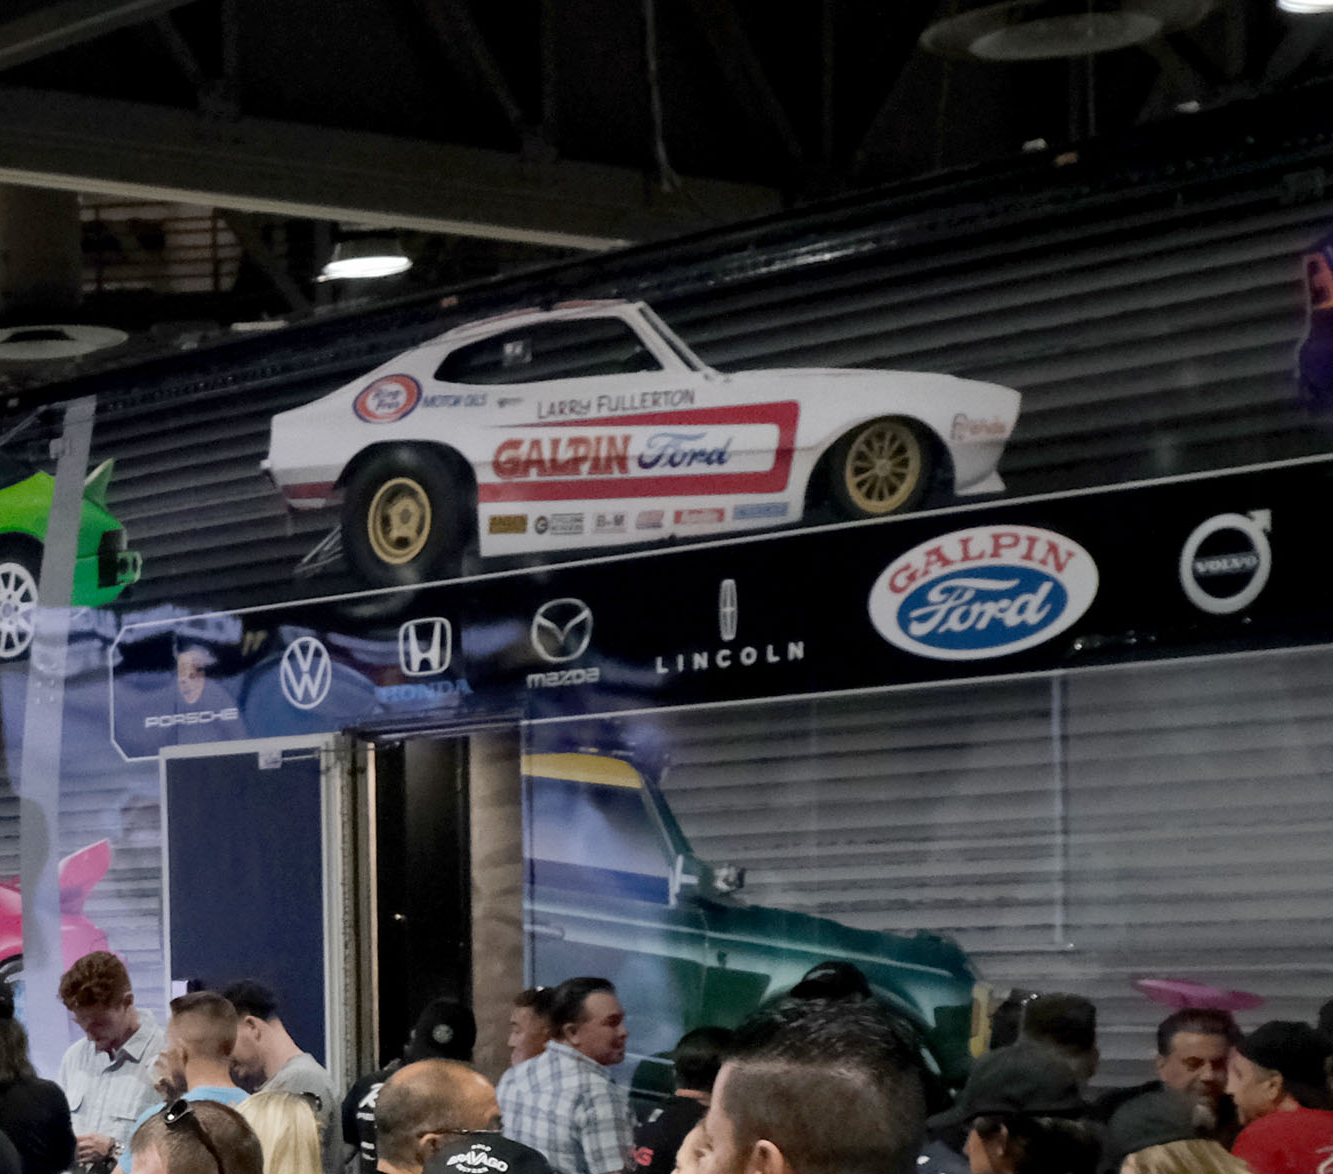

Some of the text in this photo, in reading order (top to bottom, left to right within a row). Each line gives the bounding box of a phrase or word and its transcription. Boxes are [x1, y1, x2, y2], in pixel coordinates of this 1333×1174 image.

[537, 398, 591, 420] LARRY
[596, 389, 695, 414] FULLERTON
[492, 432, 733, 481] GALPIN Ford
[888, 531, 1076, 596] GALPIN
[1195, 553, 1259, 574] VOLVO
[908, 577, 1054, 639] Ford
[655, 640, 805, 674] LINCOLN
[374, 677, 476, 703] HONDA
[145, 706, 239, 729] PORSCHE
